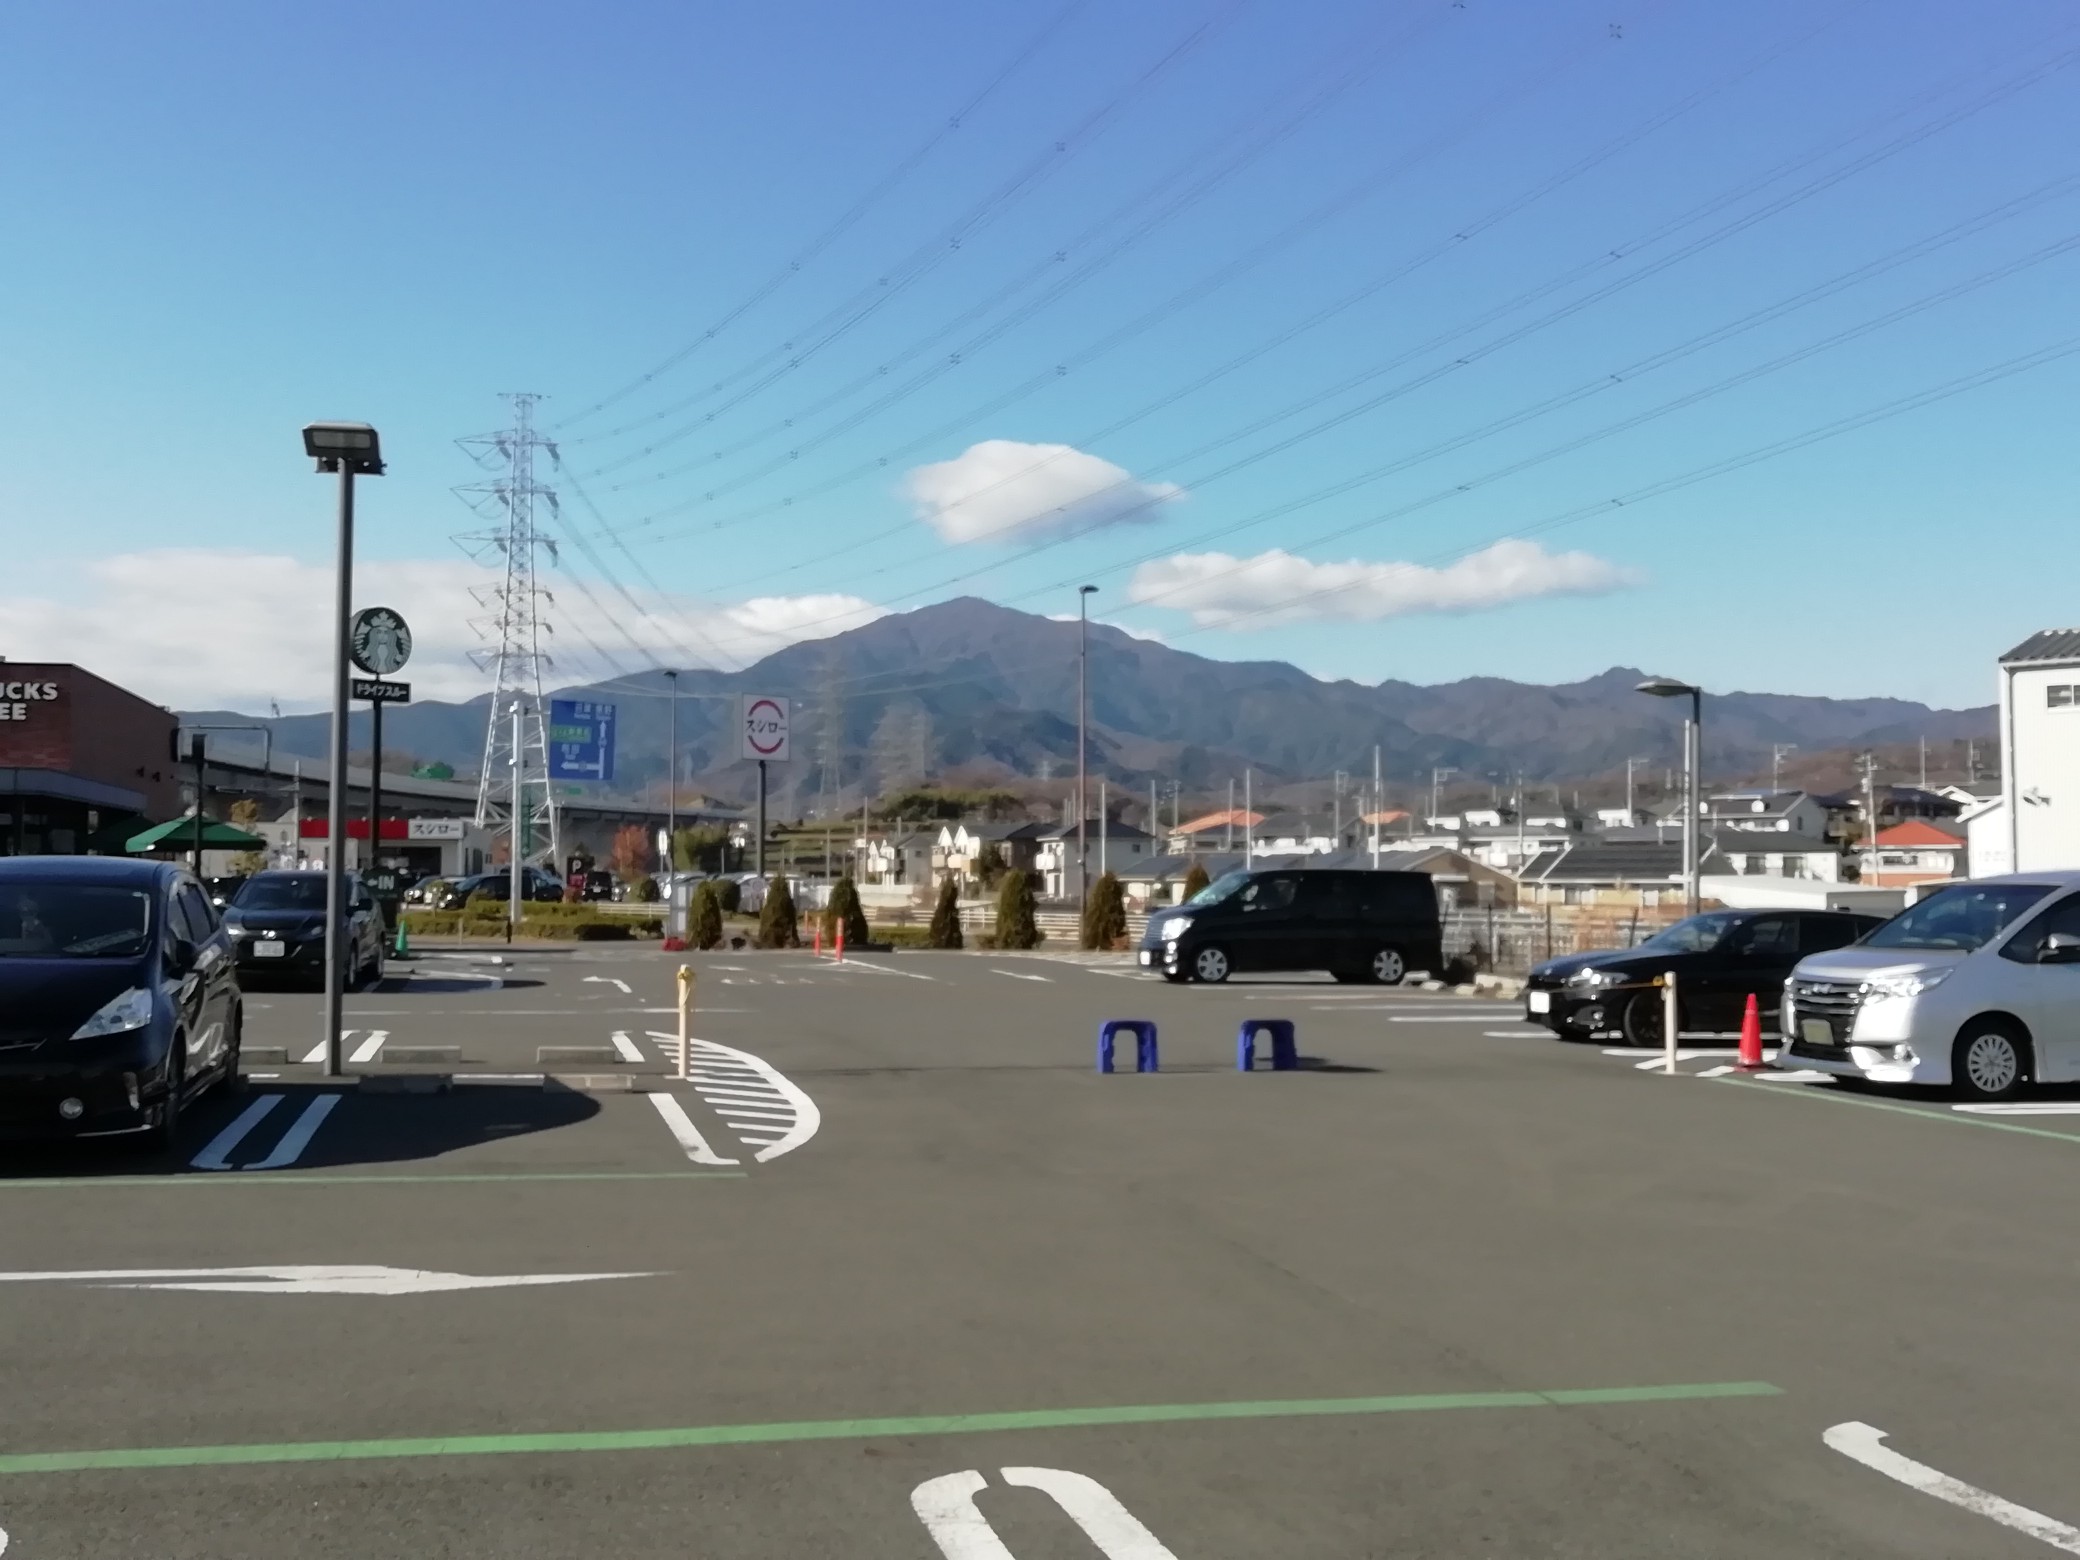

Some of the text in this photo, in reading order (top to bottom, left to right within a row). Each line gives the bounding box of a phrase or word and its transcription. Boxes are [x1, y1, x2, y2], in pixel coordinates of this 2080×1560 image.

[0, 682, 58, 700] CKS
[746, 719, 787, 733] スシロー
[413, 824, 459, 835] スシロー
[378, 875, 395, 890] IN
